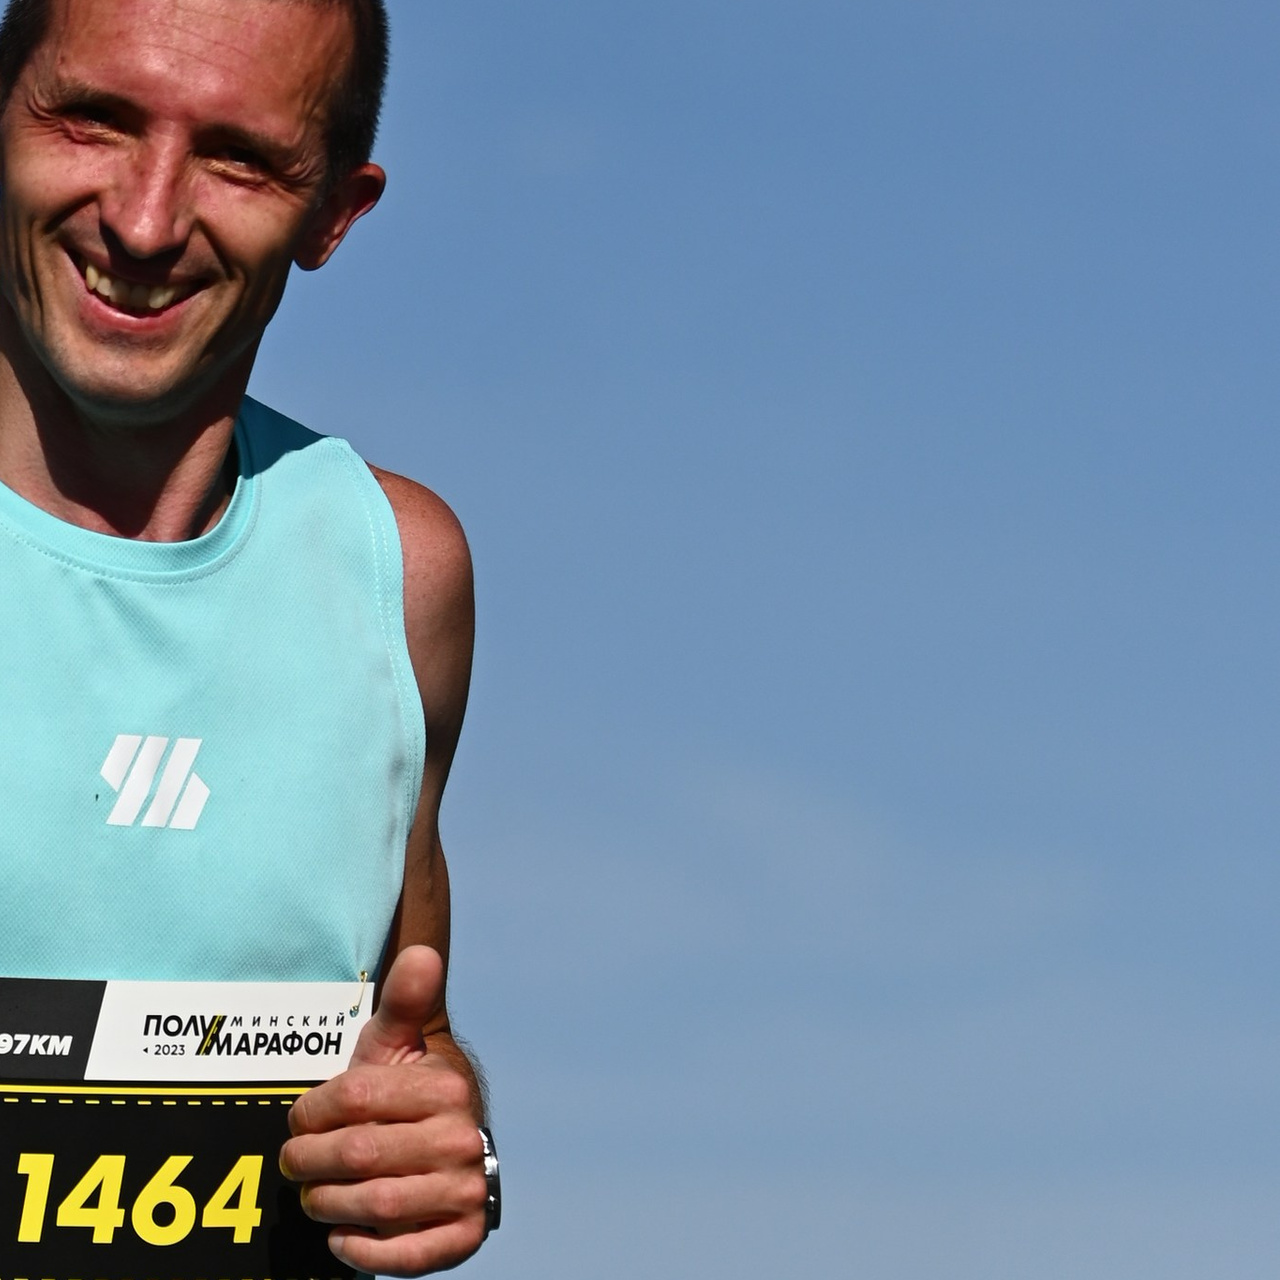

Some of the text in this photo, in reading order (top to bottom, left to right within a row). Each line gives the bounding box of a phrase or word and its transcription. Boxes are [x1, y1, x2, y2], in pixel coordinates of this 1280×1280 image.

[143, 1015, 227, 1046] ПОЛУ
[230, 1012, 345, 1027] МИНСКИЙ
[154, 1044, 186, 1056] 2023
[205, 1031, 343, 1056] МАРАФОН
[17, 1153, 264, 1246] 1464
